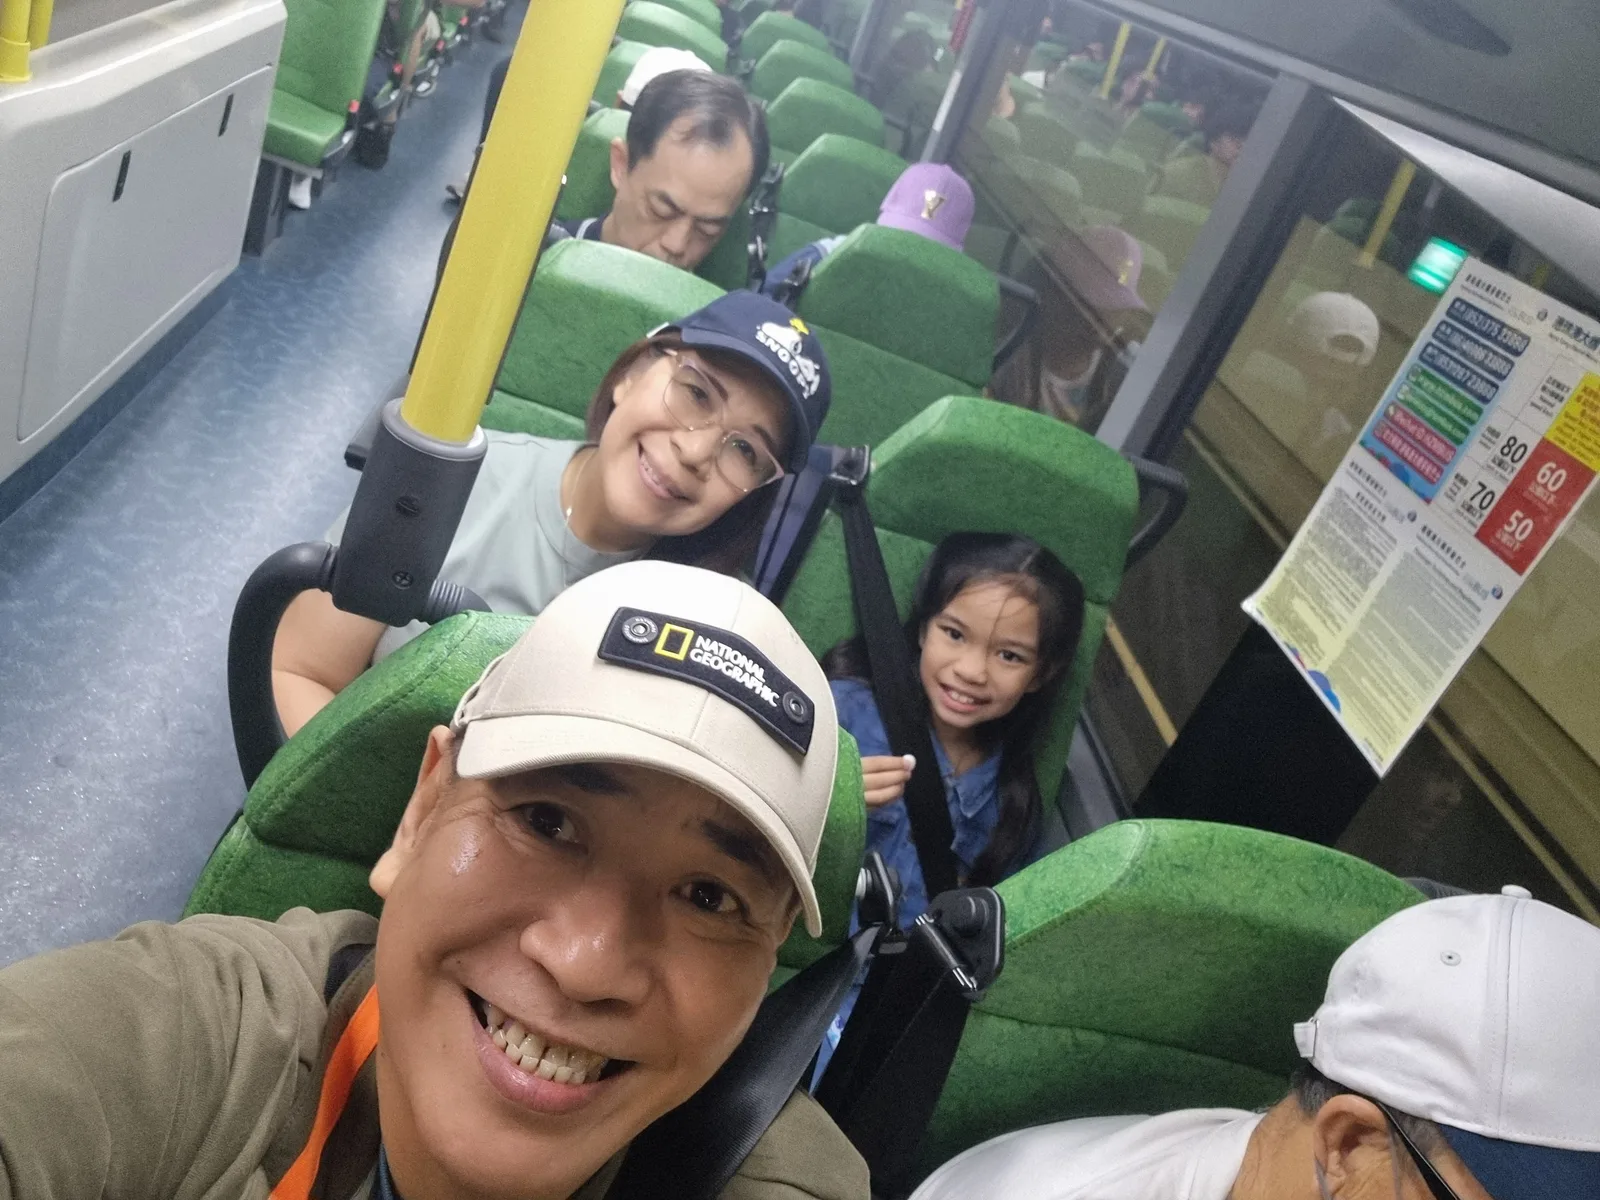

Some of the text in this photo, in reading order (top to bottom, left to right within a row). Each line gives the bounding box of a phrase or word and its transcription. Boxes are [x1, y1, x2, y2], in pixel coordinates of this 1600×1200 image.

[756, 329, 809, 399] SNOOPY
[1500, 436, 1527, 463] 80
[1536, 462, 1567, 492] 60
[1470, 481, 1495, 510] 70
[1504, 510, 1533, 541] 50
[695, 635, 766, 682] NATIONAL
[689, 649, 780, 707] GEOGRAPHIC
